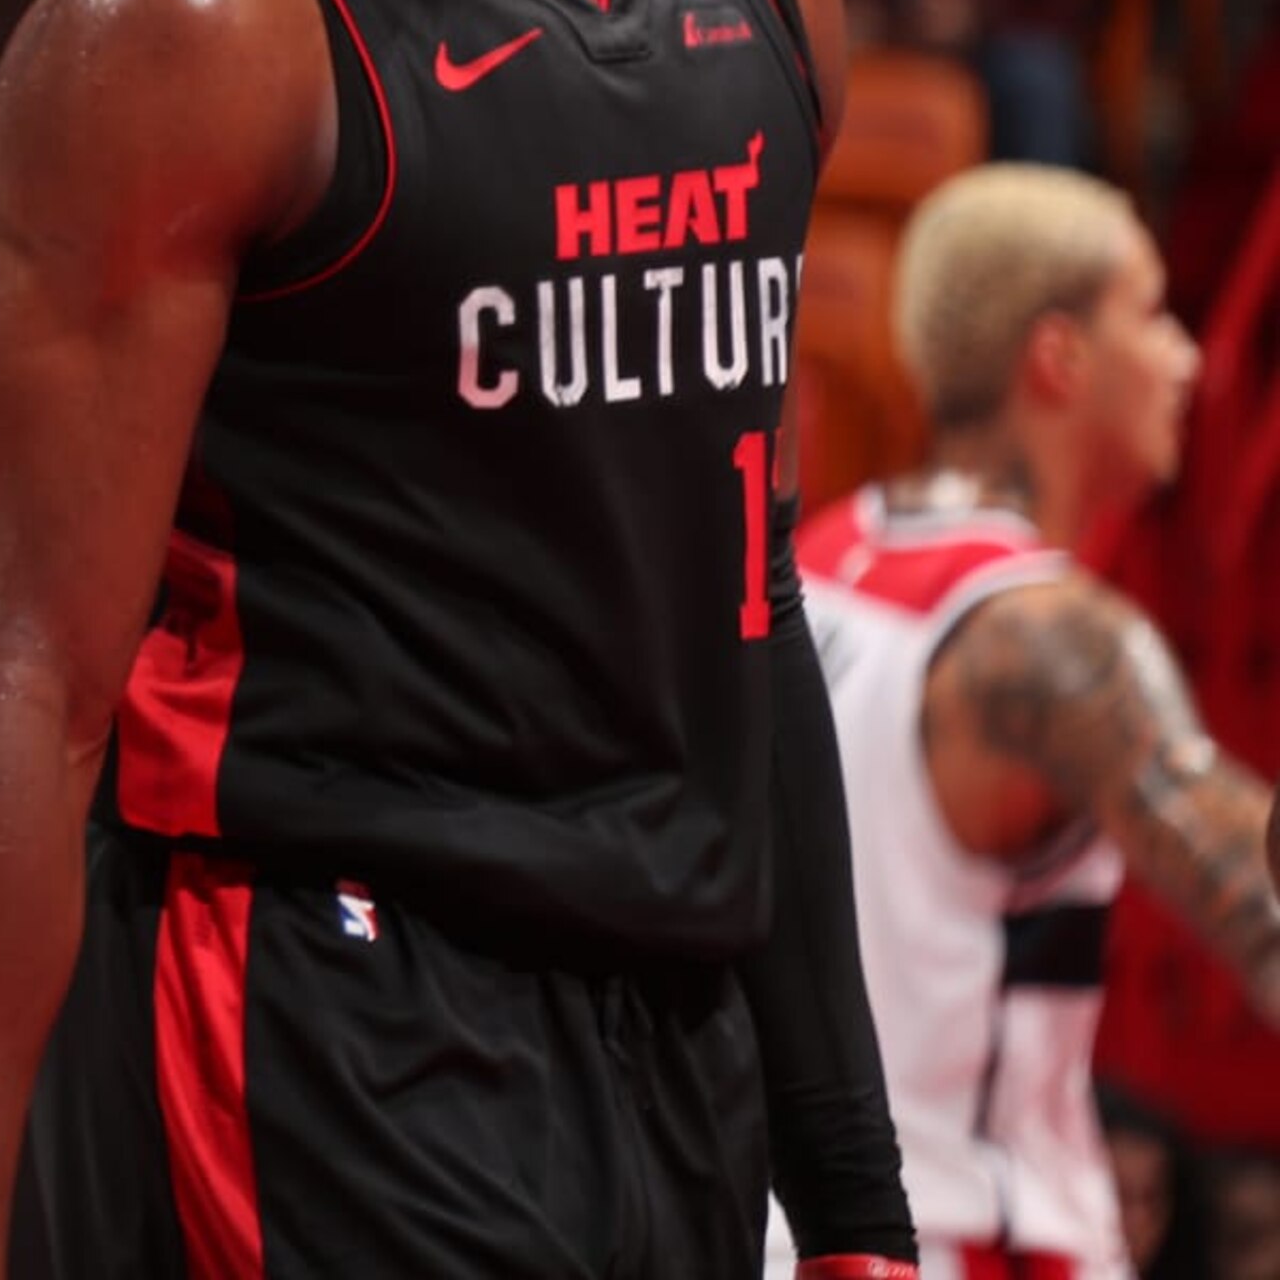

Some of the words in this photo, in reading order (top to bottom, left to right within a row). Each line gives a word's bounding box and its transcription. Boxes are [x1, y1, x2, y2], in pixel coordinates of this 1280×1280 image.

[554, 132, 765, 261] HEAT
[457, 253, 804, 408] CULTUR
[732, 427, 783, 640] 1
